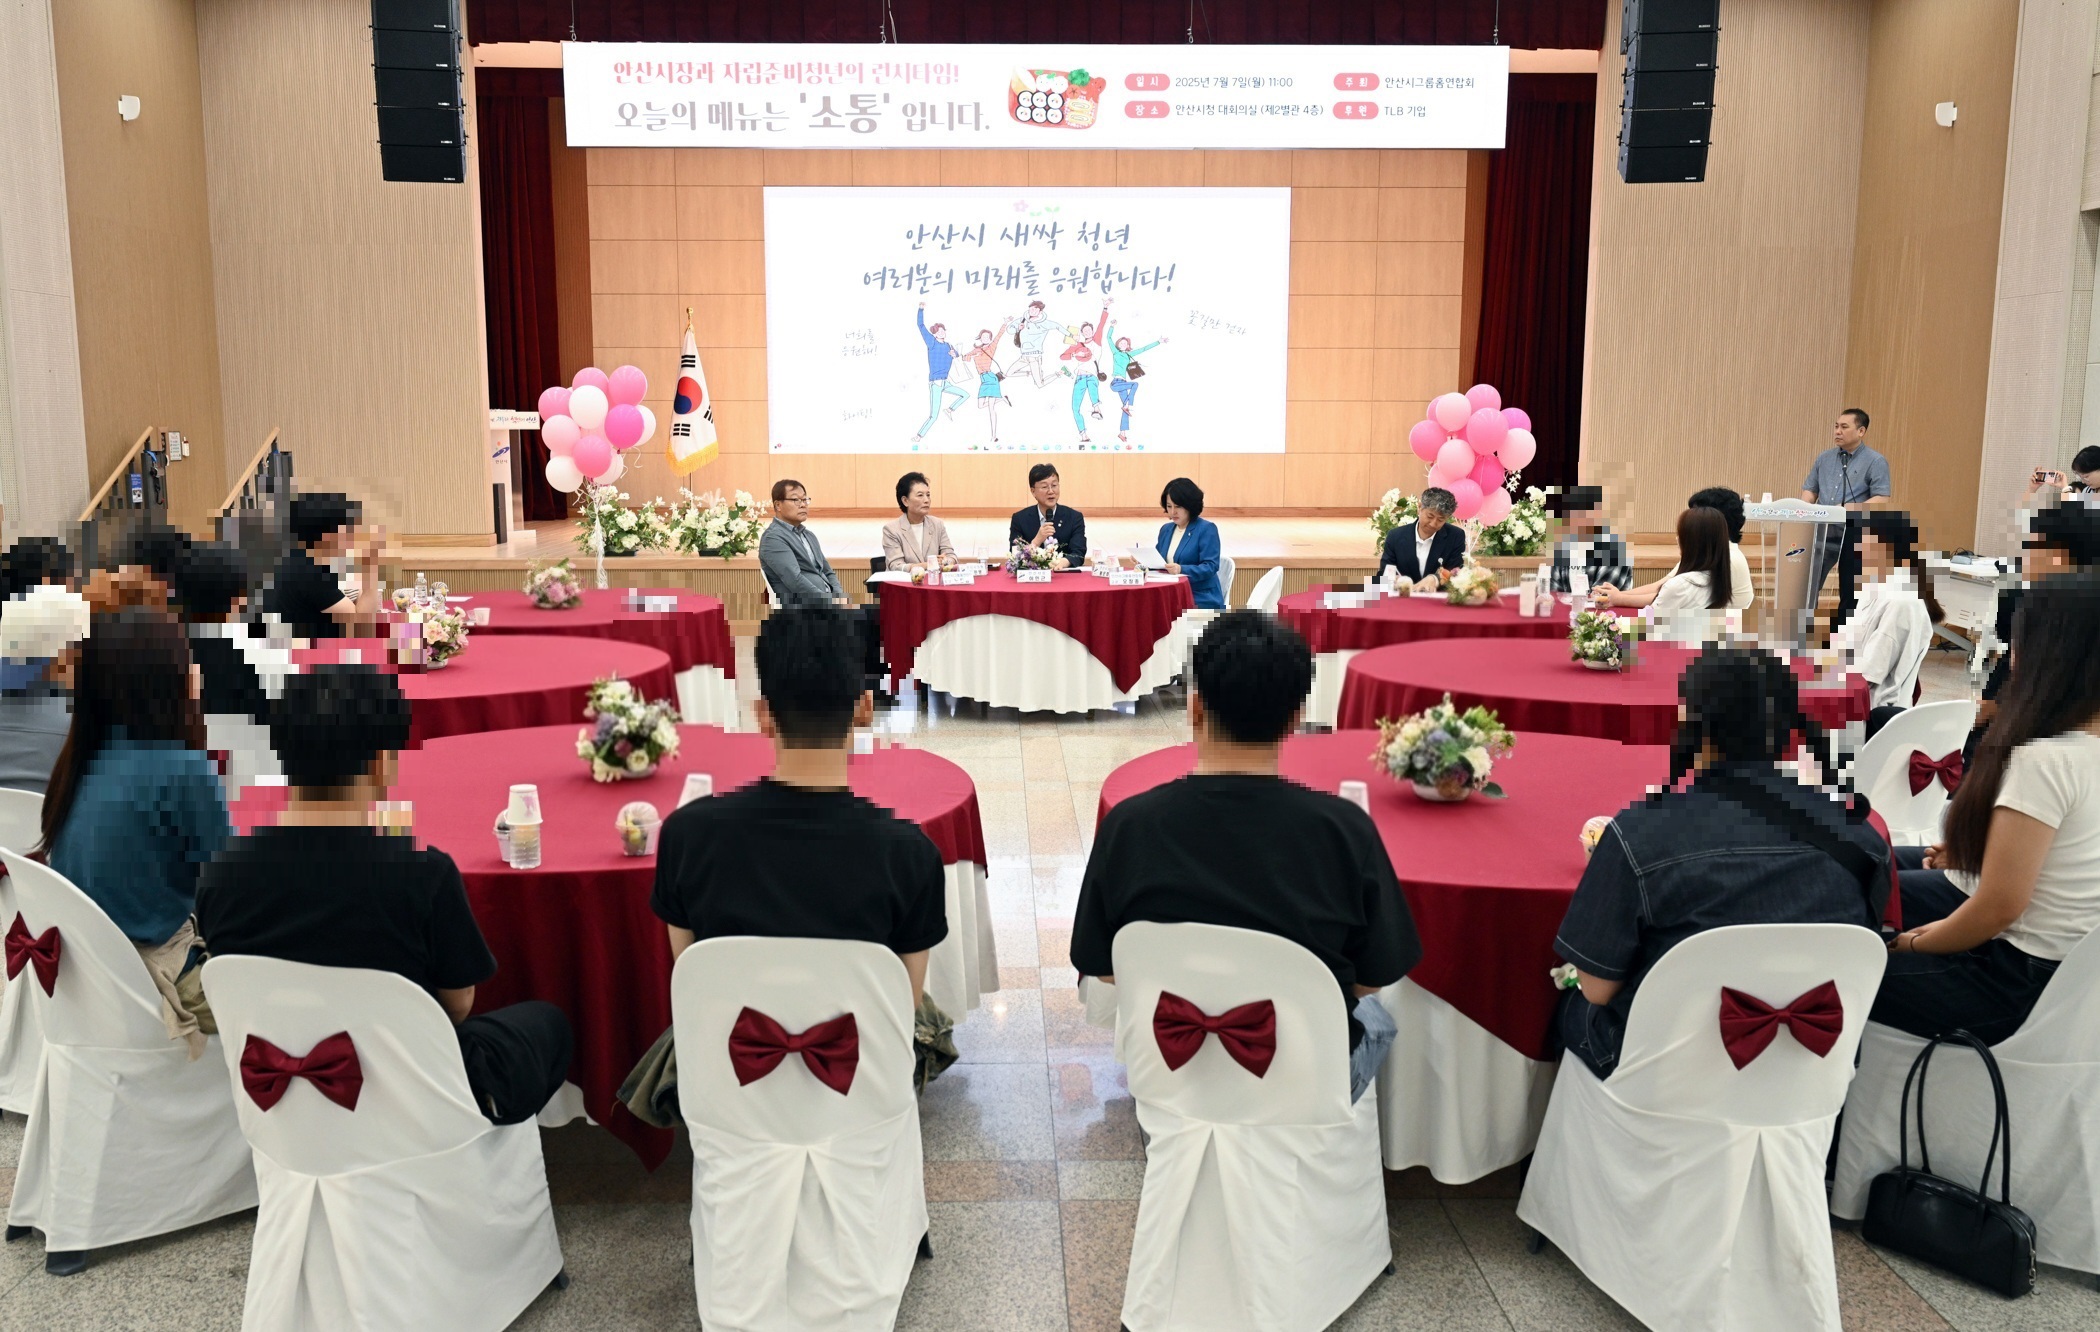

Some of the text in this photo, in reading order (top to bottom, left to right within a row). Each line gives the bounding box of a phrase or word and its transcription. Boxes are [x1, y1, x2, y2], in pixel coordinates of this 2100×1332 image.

[613, 61, 960, 85] 안산시장과 자립준비청년의 런치타임!
[1175, 76, 1293, 89] 2025년 7월 7일(월) 11:00
[1384, 76, 1475, 89] 안산시그룹홈연합회
[614, 92, 990, 134] 오늘의 메뉴는 '소통' 입니다.
[1175, 104, 1324, 116] 안산시청 대회의실 (제2별관 4층)
[1384, 106, 1426, 117] TLB 기업
[905, 220, 1130, 252] 안산시 새싹 청년
[863, 259, 1176, 301] 여러분의 미래를 응원합니다!
